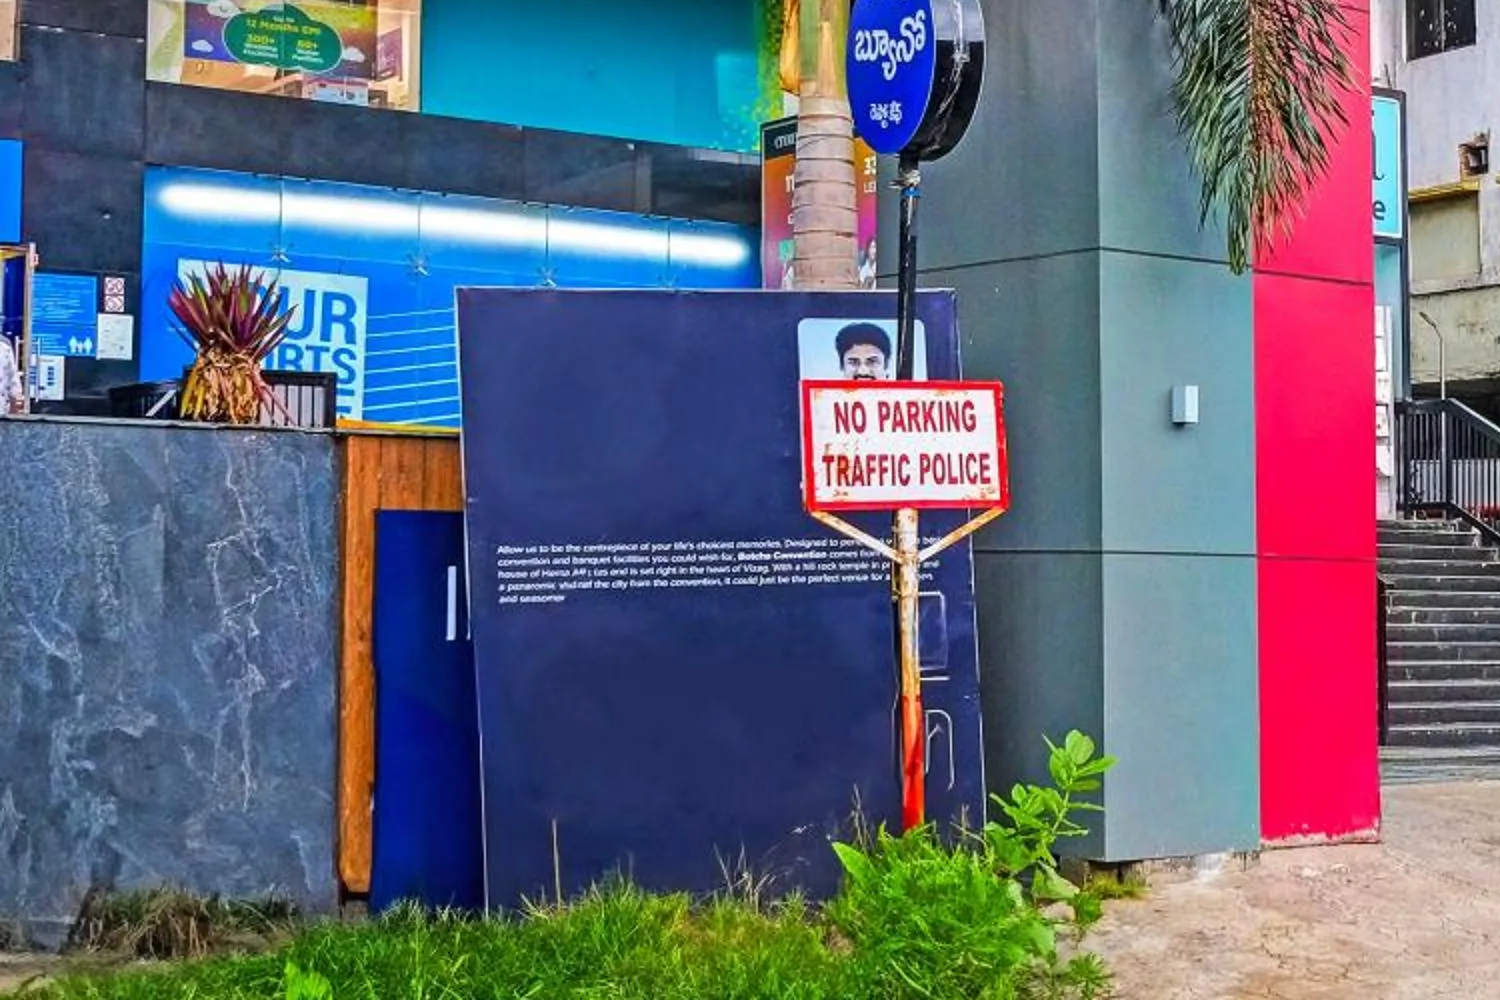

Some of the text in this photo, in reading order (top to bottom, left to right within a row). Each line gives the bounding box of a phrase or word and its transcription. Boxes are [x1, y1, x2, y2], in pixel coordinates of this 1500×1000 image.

[834, 400, 977, 434] NO PARKING
[822, 452, 991, 488] TRAFFIC POLICE
